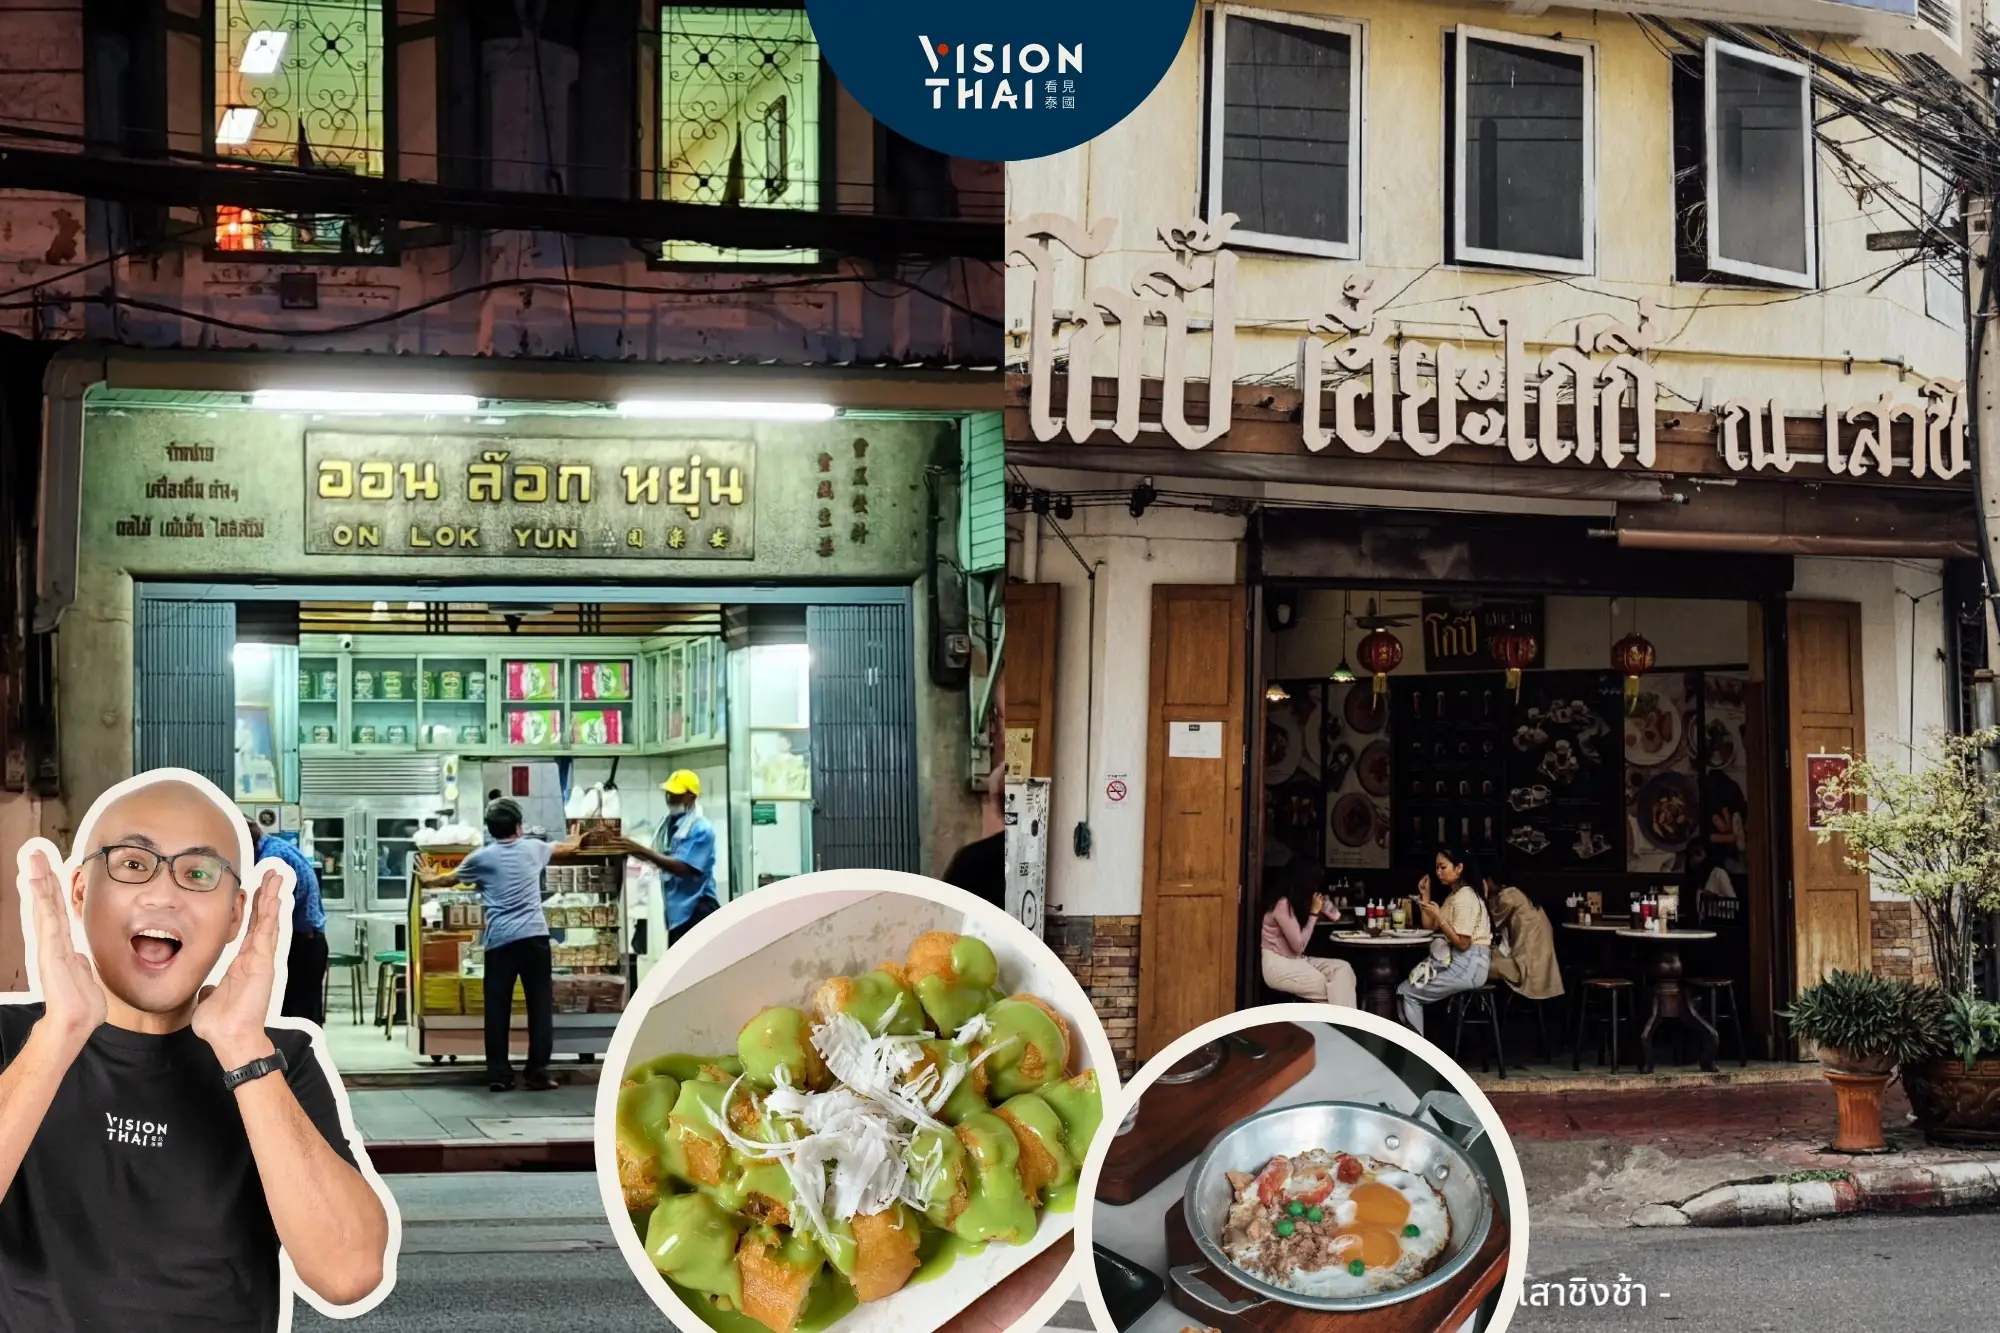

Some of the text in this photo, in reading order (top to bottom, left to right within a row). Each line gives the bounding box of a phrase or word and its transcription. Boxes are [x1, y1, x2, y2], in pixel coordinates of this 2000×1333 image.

[1723, 397, 1797, 473] ณ
[318, 451, 744, 518] ออน ล๊อก หยุ่น
[332, 524, 578, 549] ON LOK YUN
[105, 1112, 168, 1135] VISION
[106, 1127, 148, 1147] THAI
